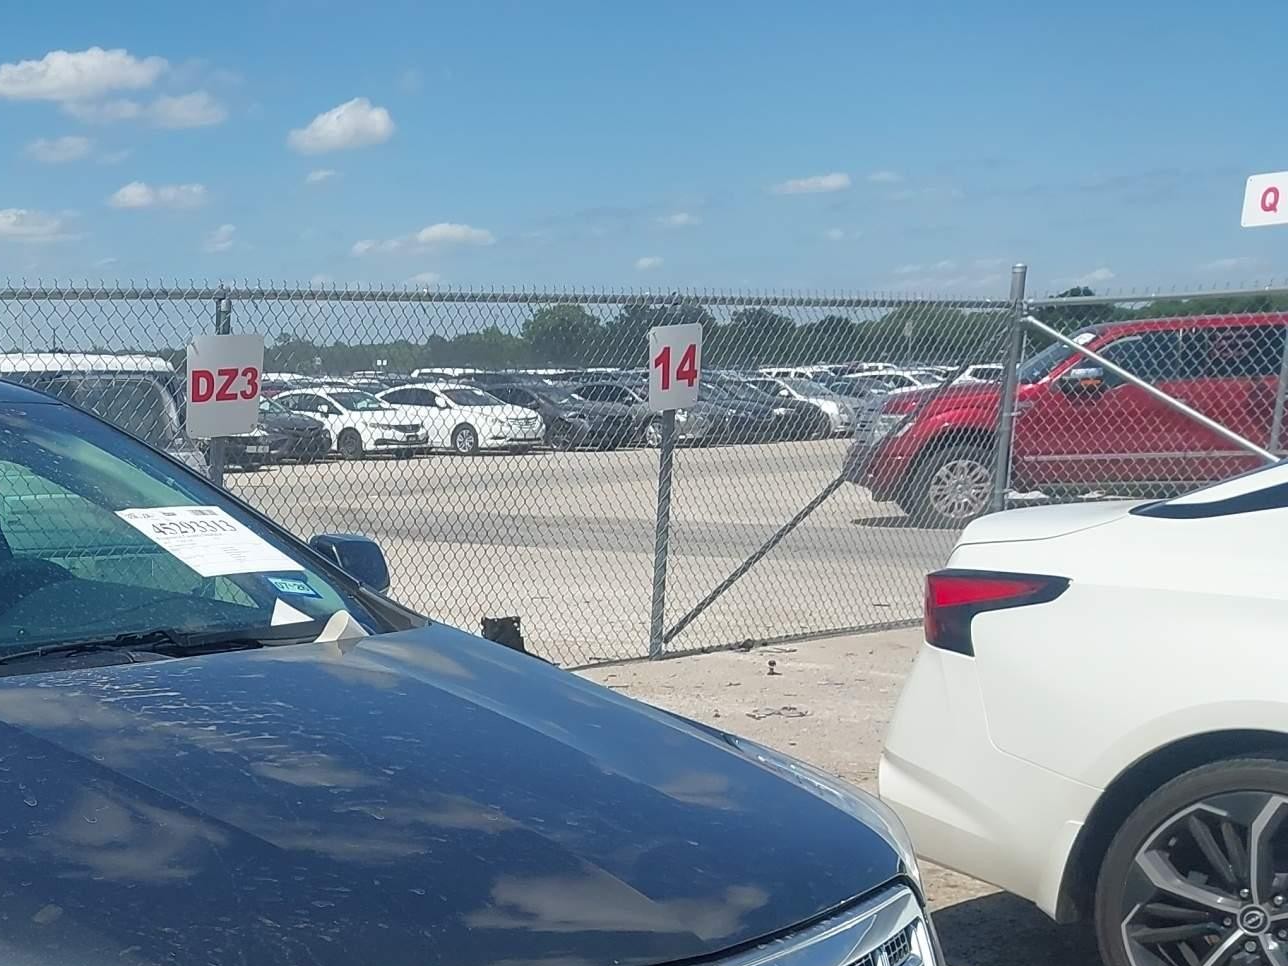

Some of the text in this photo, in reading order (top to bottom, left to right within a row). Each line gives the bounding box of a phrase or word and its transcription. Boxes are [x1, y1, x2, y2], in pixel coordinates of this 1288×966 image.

[1260, 186, 1280, 213] Q
[654, 343, 698, 391] 14
[191, 367, 259, 403] DZ3
[151, 519, 237, 536] 45293313
